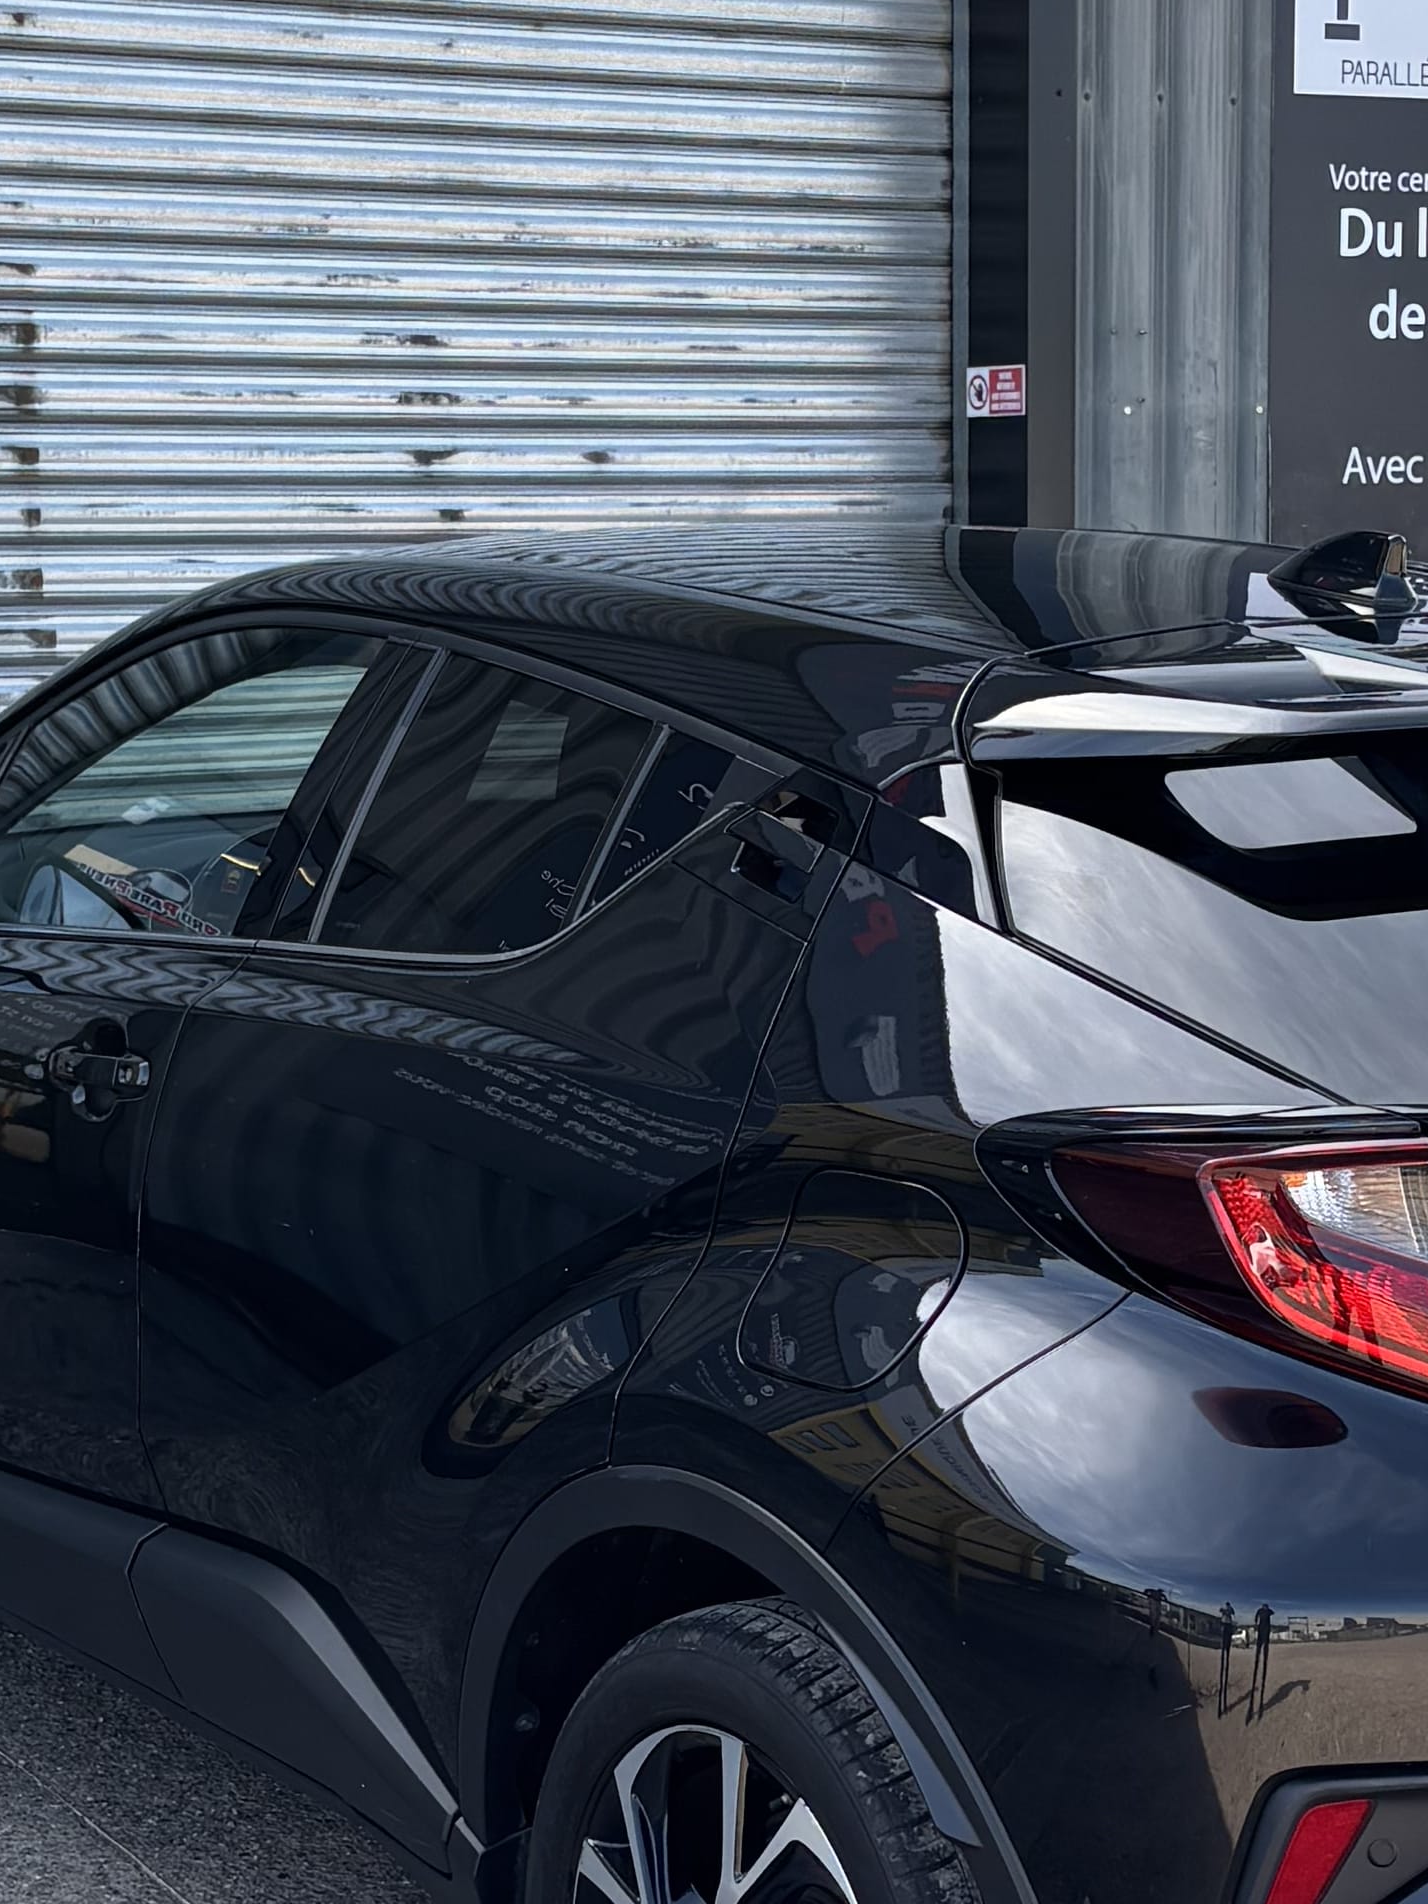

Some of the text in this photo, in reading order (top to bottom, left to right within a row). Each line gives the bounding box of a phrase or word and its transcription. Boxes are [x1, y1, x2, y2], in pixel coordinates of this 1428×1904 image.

[1329, 164, 1391, 192] Votre
[1339, 207, 1402, 258] Du
[1368, 288, 1426, 340] de
[1342, 446, 1424, 486] Avec
